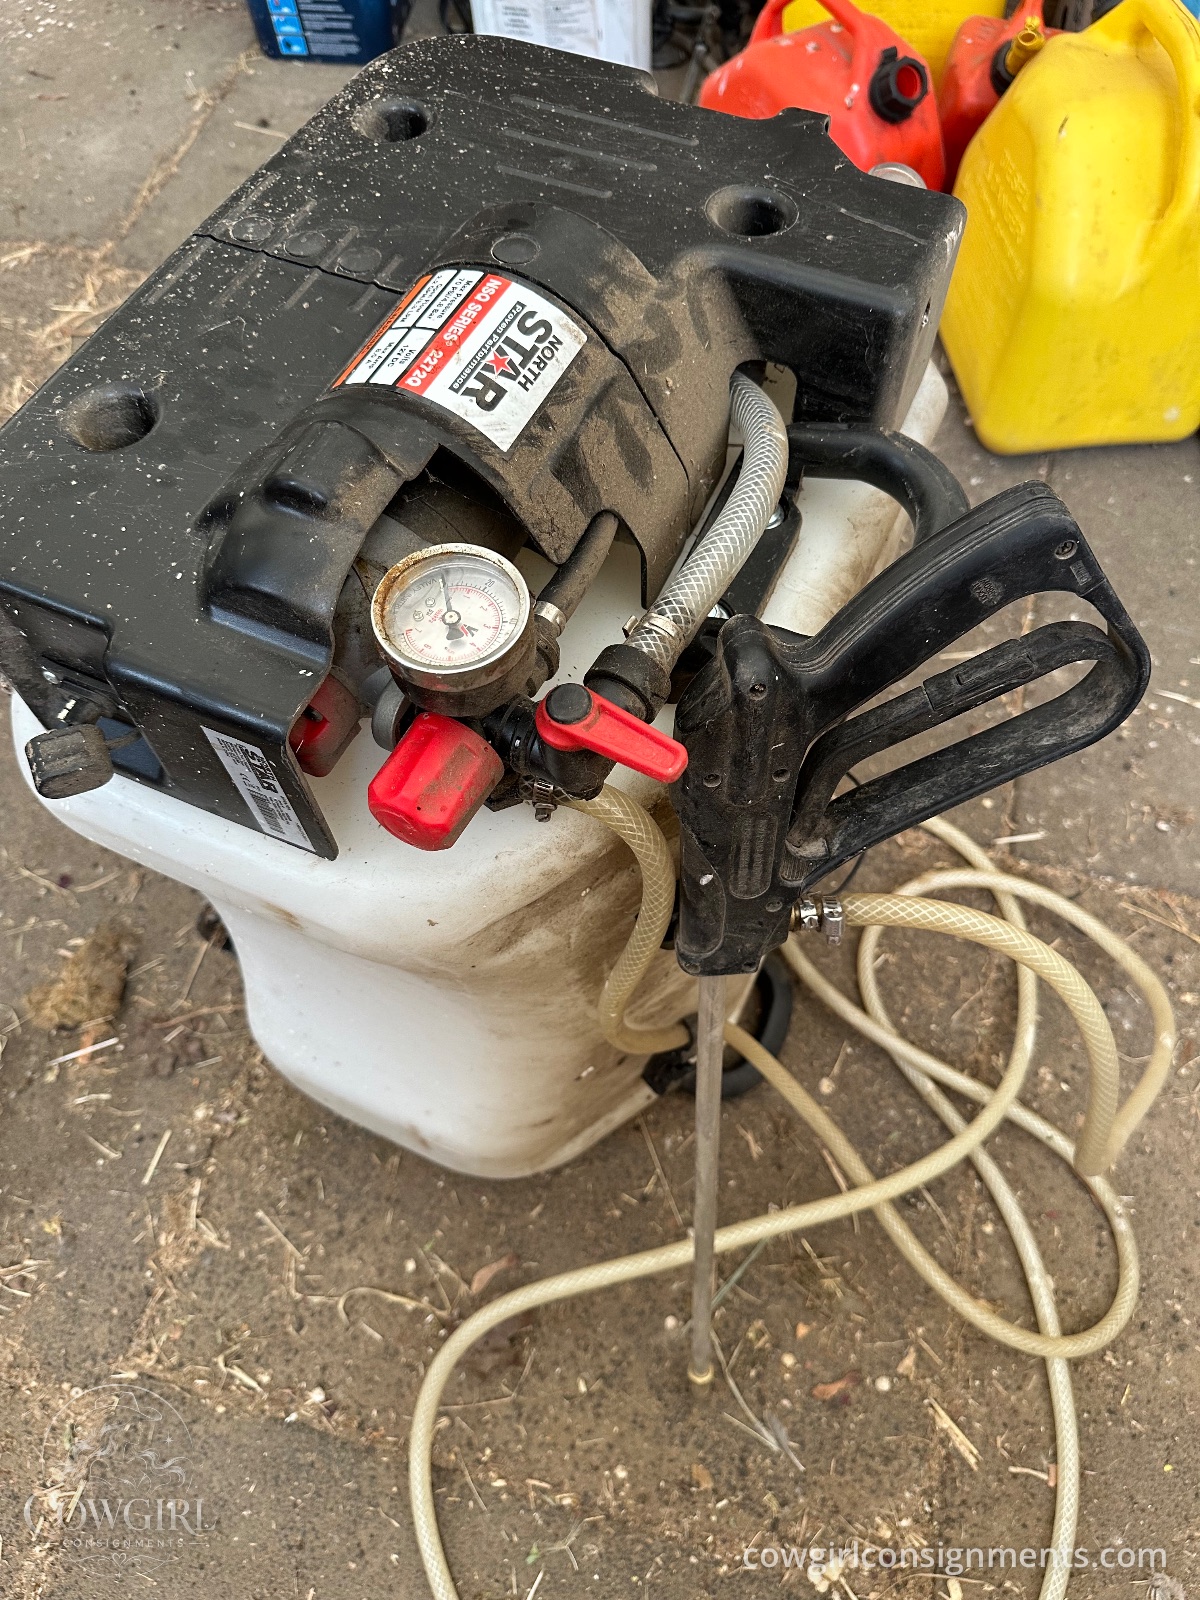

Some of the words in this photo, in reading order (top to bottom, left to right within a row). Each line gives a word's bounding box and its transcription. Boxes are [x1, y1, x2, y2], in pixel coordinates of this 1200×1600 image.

[475, 278, 503, 303] NSQ
[496, 304, 523, 336] Proven
[399, 348, 417, 365] Volts
[405, 349, 445, 388] 2272Q
[452, 337, 496, 389] Performance
[461, 311, 553, 412] STAR
[518, 335, 563, 392] NORTH
[412, 578, 436, 594] VALLEY
[248, 751, 278, 794] STAR
